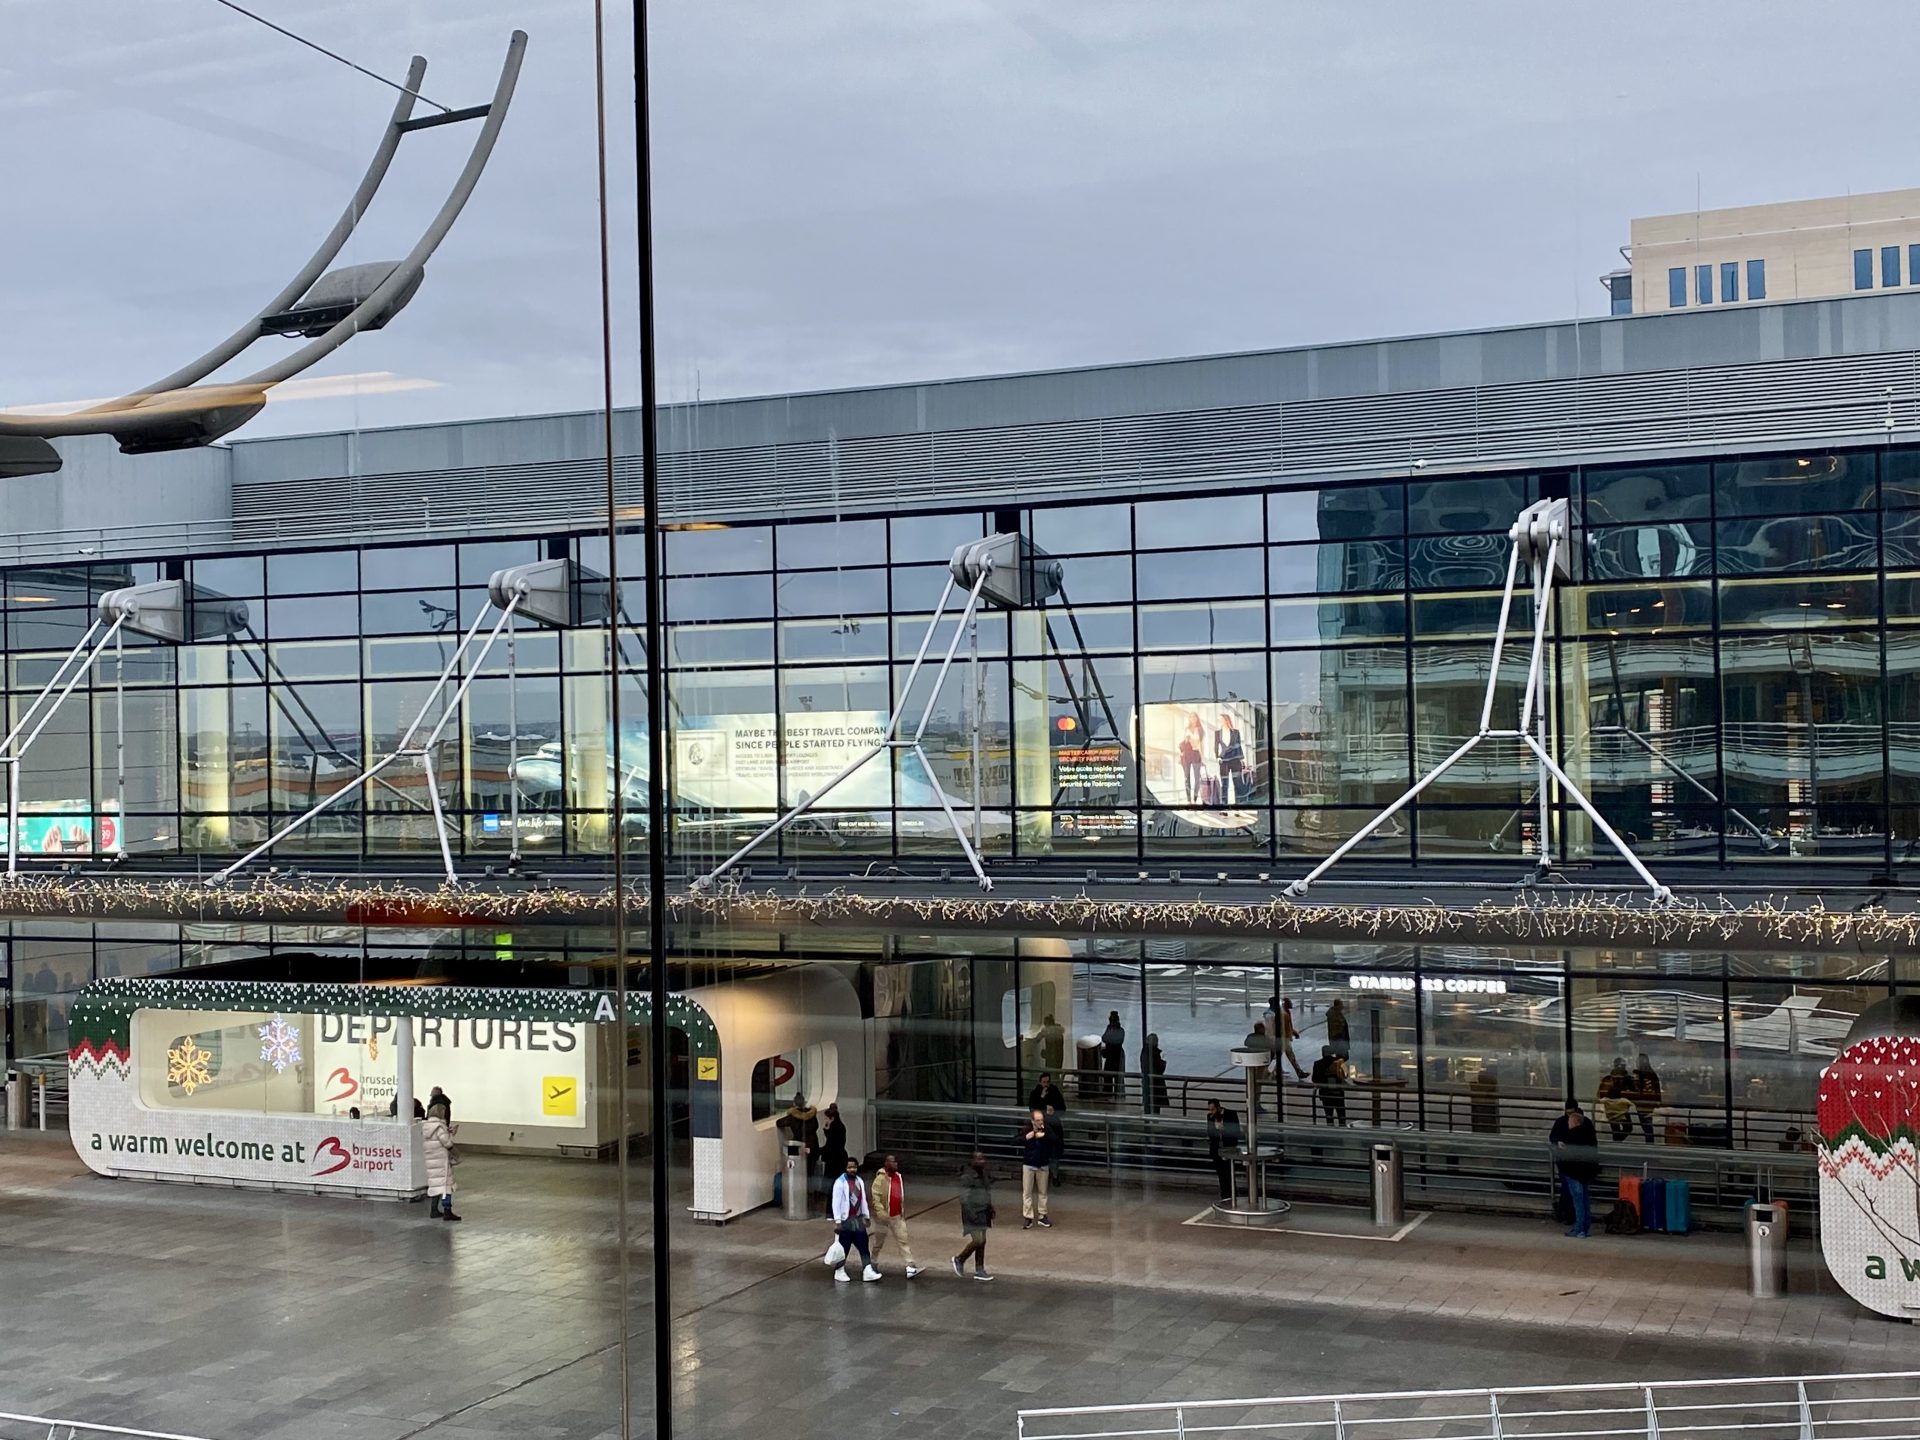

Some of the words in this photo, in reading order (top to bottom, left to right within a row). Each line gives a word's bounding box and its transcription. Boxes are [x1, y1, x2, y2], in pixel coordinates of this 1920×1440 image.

[736, 729, 766, 738] MAYBE
[787, 728, 810, 737] BEST
[812, 727, 845, 737] TRAVEL
[847, 726, 889, 736] COMPAN
[736, 740, 763, 749] SINCE
[766, 740, 801, 749] PEPLE
[802, 738, 844, 748] STARTED
[847, 738, 881, 748] FLYING
[1350, 975, 1445, 992] STARBUKS
[1445, 978, 1507, 994] COFFEE
[594, 994, 617, 1021] A
[320, 1013, 577, 1053] DEPRTURES
[91, 1132, 102, 1151] a
[108, 1134, 168, 1154] warm
[175, 1132, 274, 1161] welcome
[281, 1141, 305, 1164] at
[352, 1143, 402, 1158] brussels
[352, 1158, 395, 1173] airport
[1865, 1255, 1886, 1280] a
